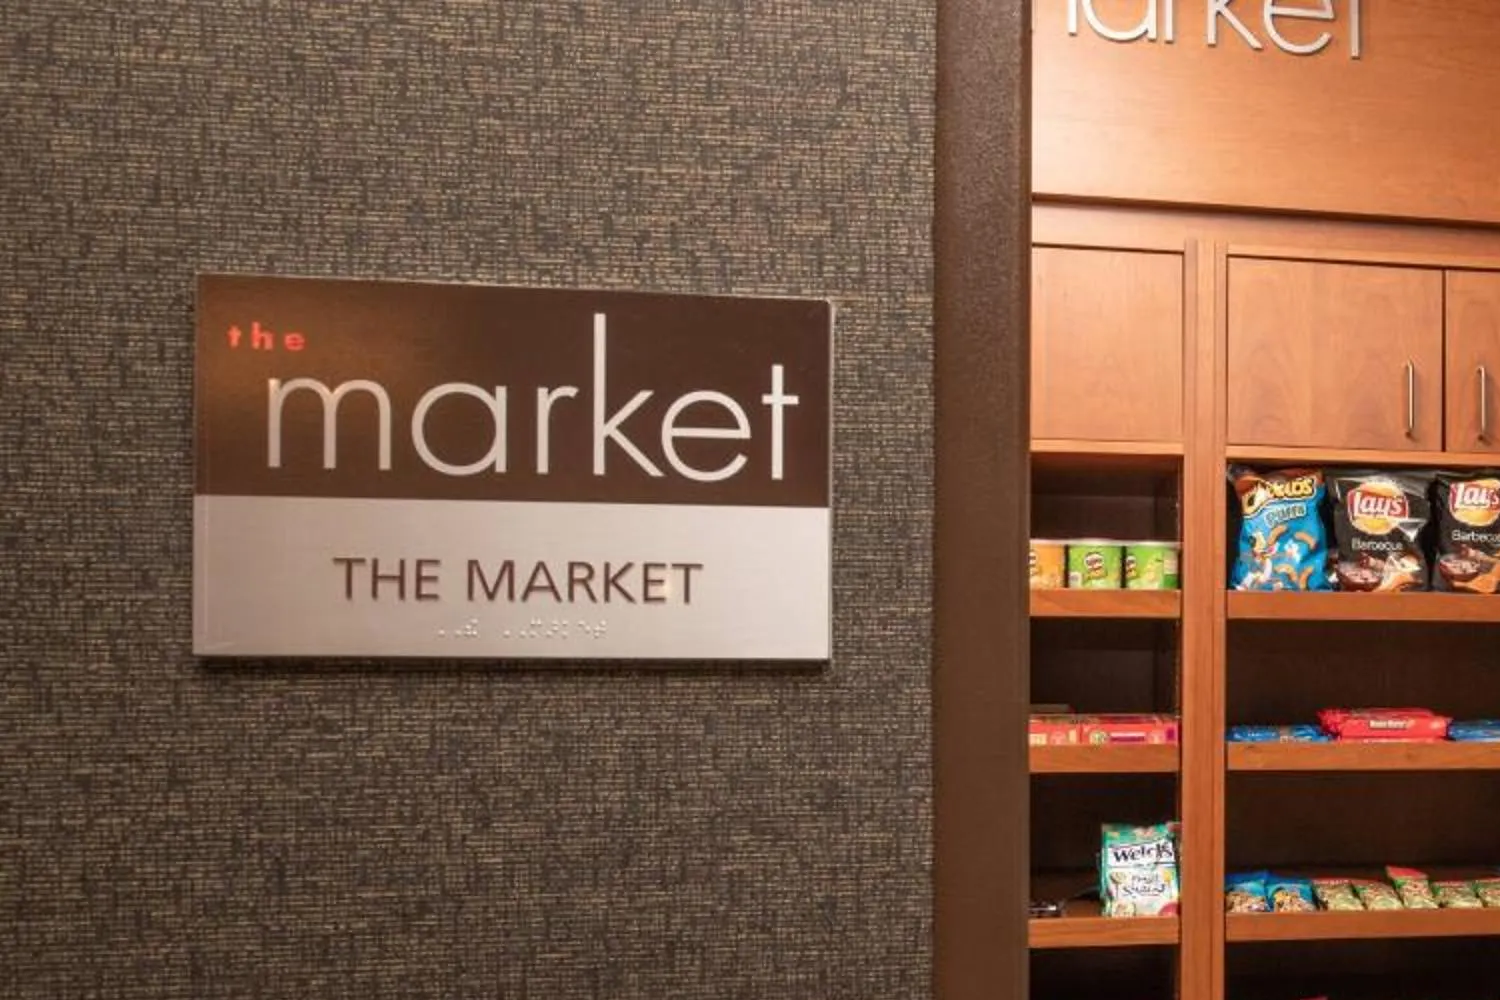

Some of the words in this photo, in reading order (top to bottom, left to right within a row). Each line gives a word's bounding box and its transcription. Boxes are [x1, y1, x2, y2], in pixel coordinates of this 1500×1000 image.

[228, 324, 306, 352] the
[267, 312, 799, 482] market
[333, 557, 441, 601] THE
[466, 558, 703, 604] MARKET
